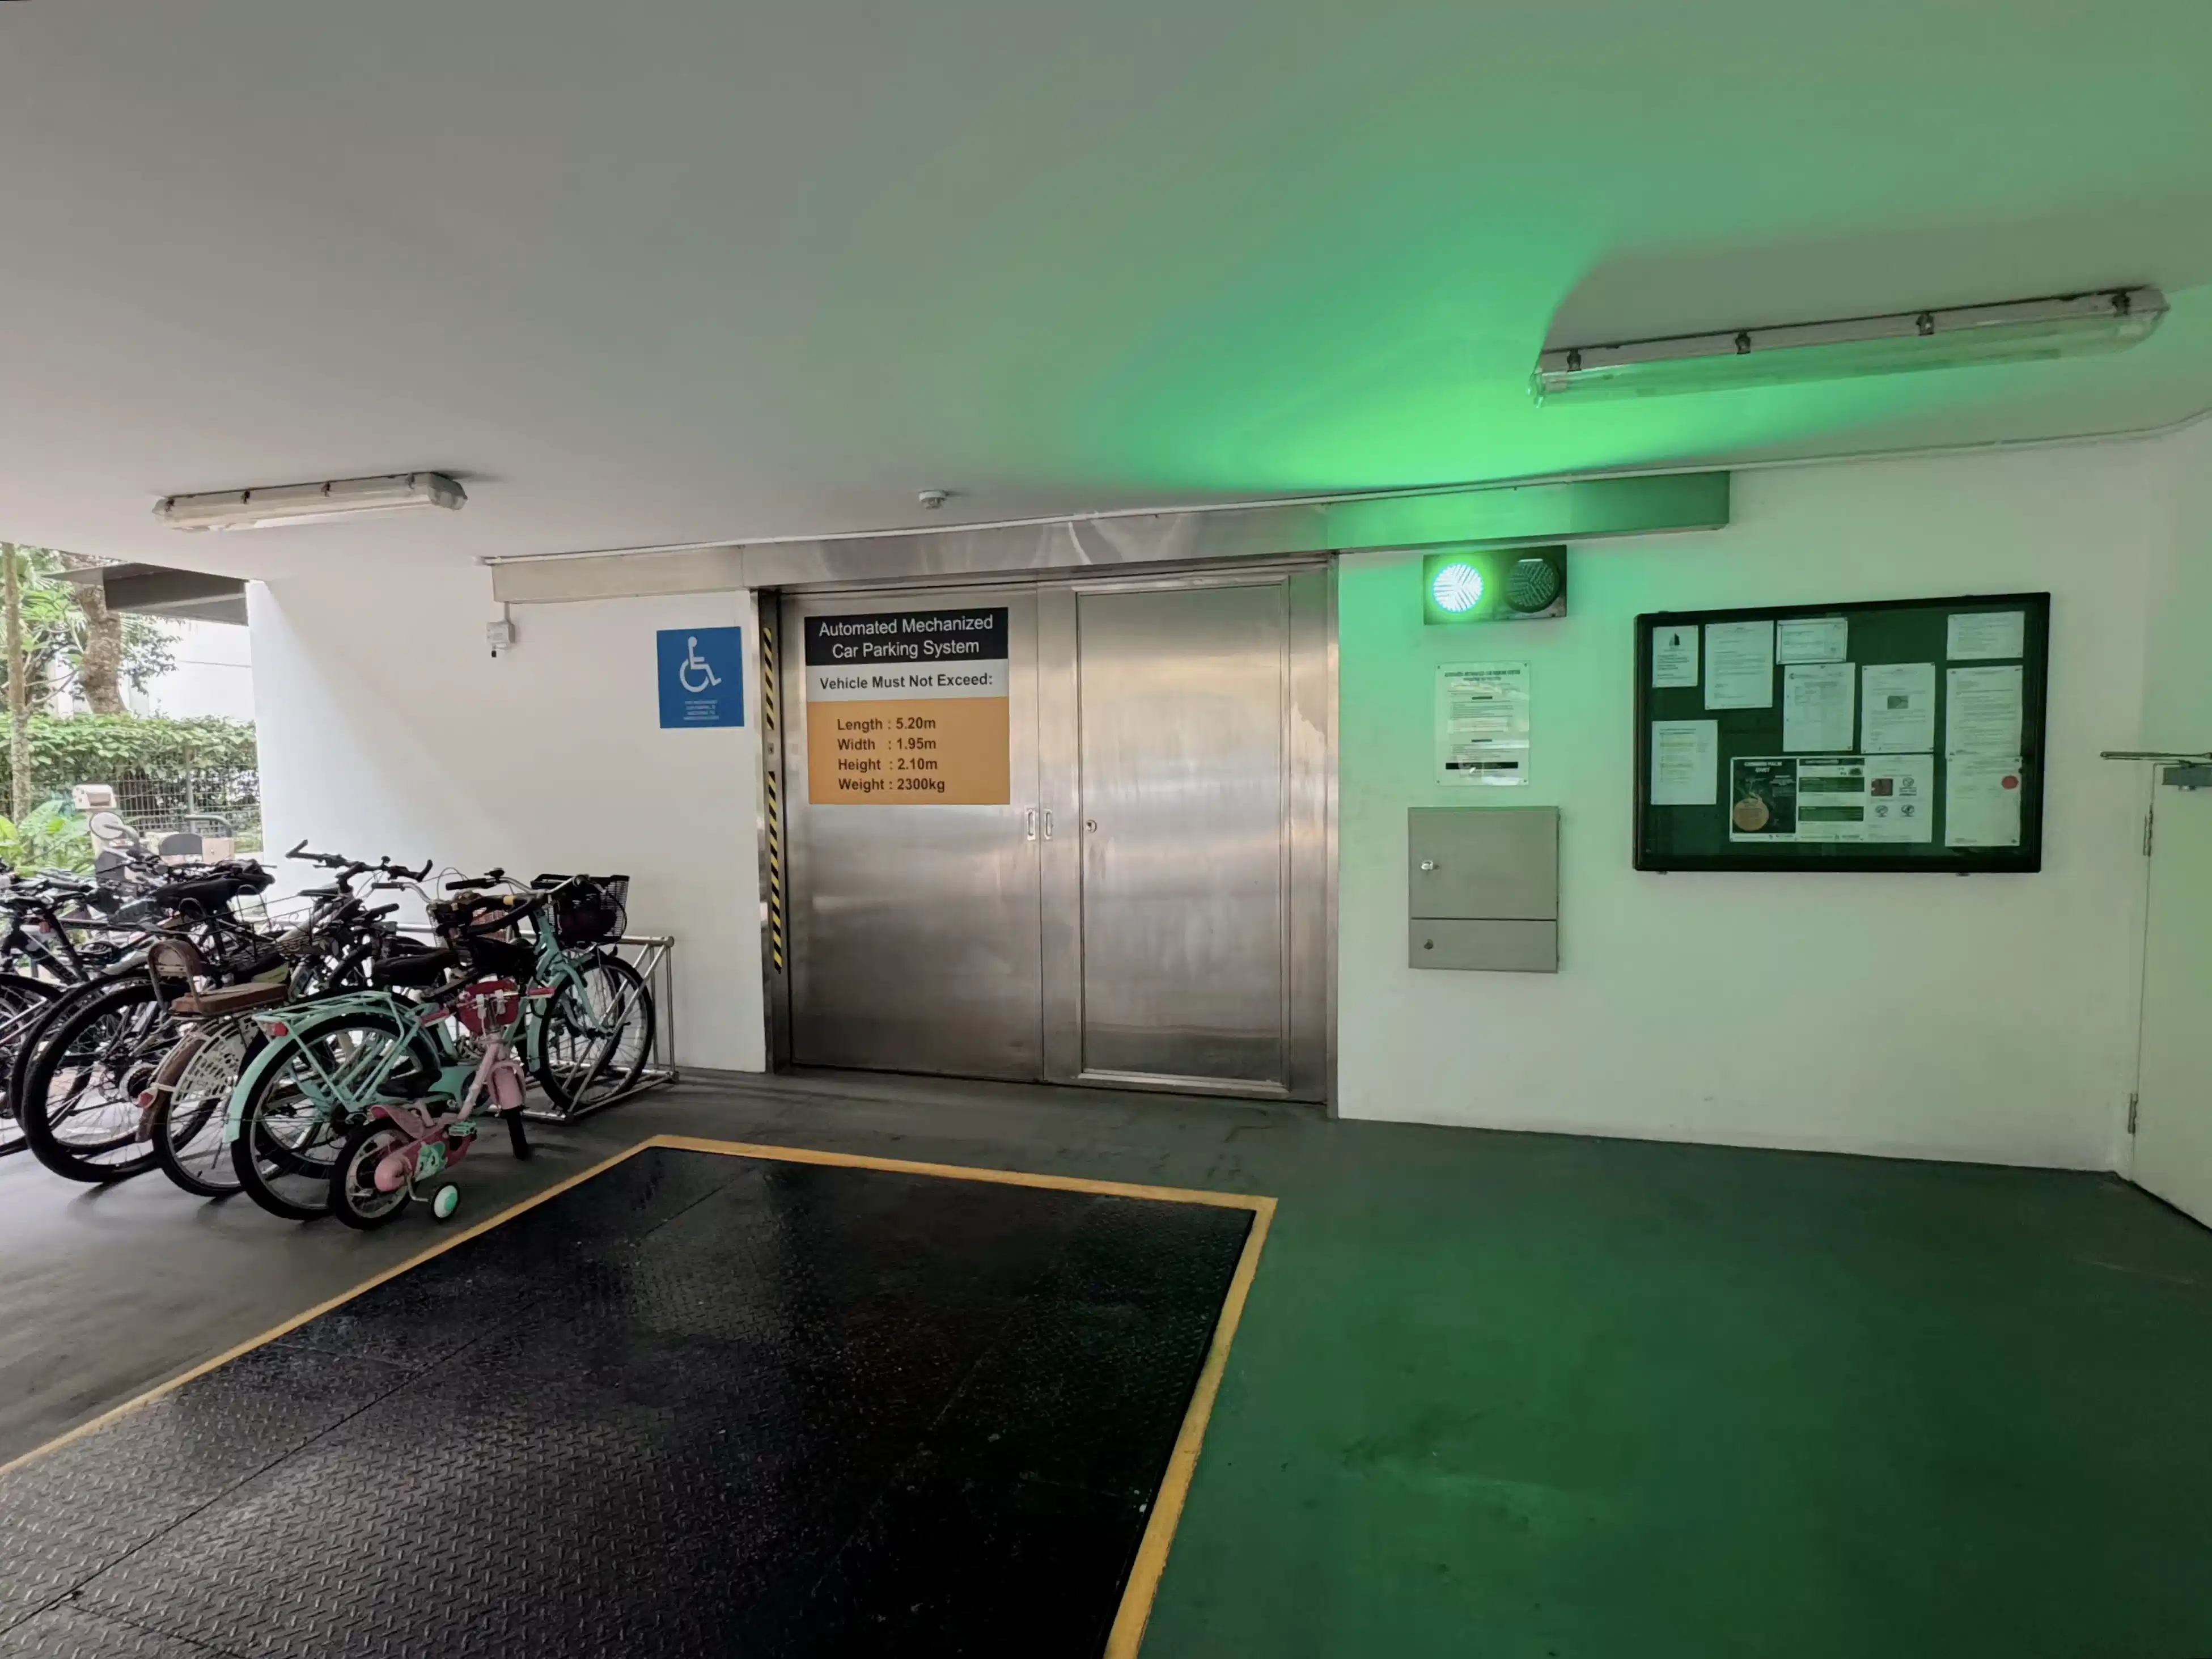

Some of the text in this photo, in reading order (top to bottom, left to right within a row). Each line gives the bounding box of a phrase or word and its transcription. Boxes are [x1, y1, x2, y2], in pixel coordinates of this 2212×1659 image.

[819, 615, 993, 637] Automated Mechanized
[832, 640, 980, 658] Car Parking System
[820, 672, 993, 689] Vehicle Must Not Exceed:
[837, 718, 883, 733] Length
[896, 717, 936, 729] 5.20m
[837, 738, 875, 750] Width
[897, 738, 936, 750] 1.95m
[838, 758, 881, 773] Height
[898, 758, 938, 770] 2.10m
[839, 778, 884, 793] Weight
[897, 778, 945, 792] 2300kg
